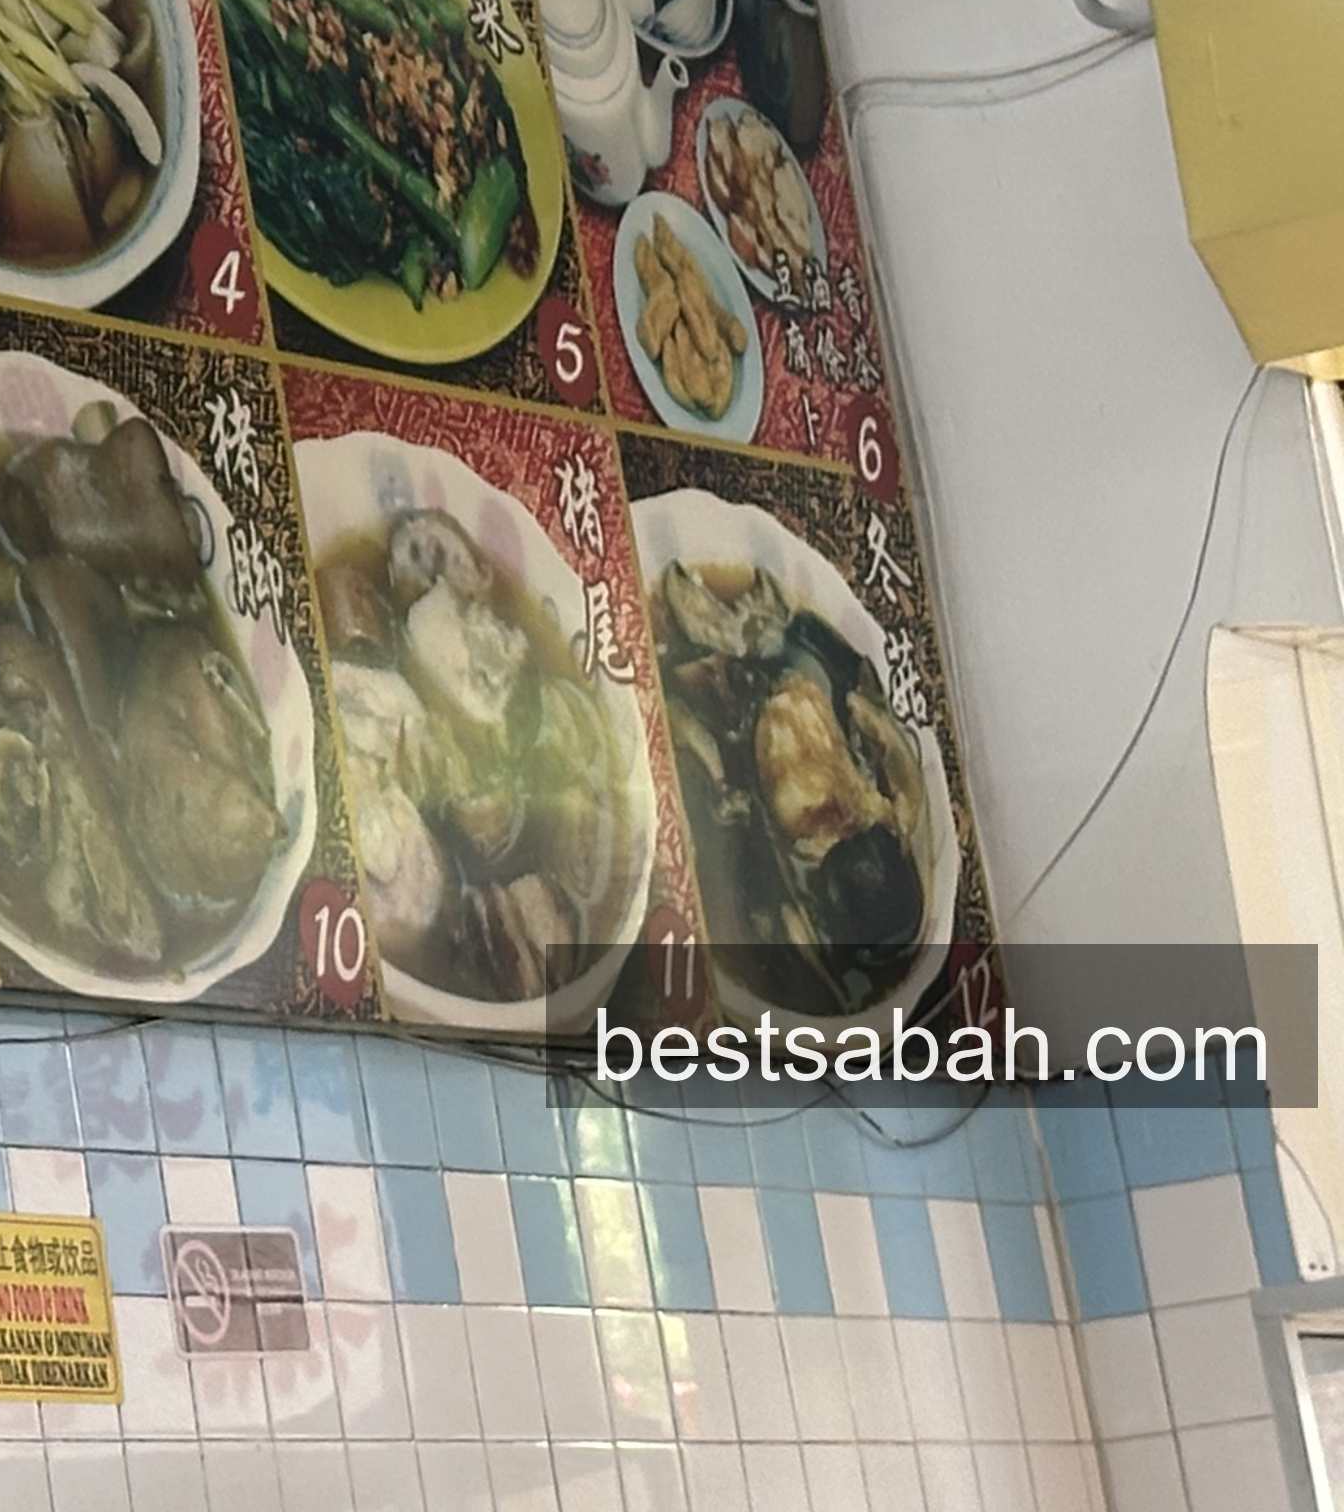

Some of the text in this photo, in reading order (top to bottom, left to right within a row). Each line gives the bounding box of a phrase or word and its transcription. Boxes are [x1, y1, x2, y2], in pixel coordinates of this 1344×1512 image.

[210, 250, 246, 313] 4
[555, 323, 584, 384] 5
[858, 416, 882, 482] 6
[314, 905, 366, 982] 10
[660, 930, 696, 1000] 11
